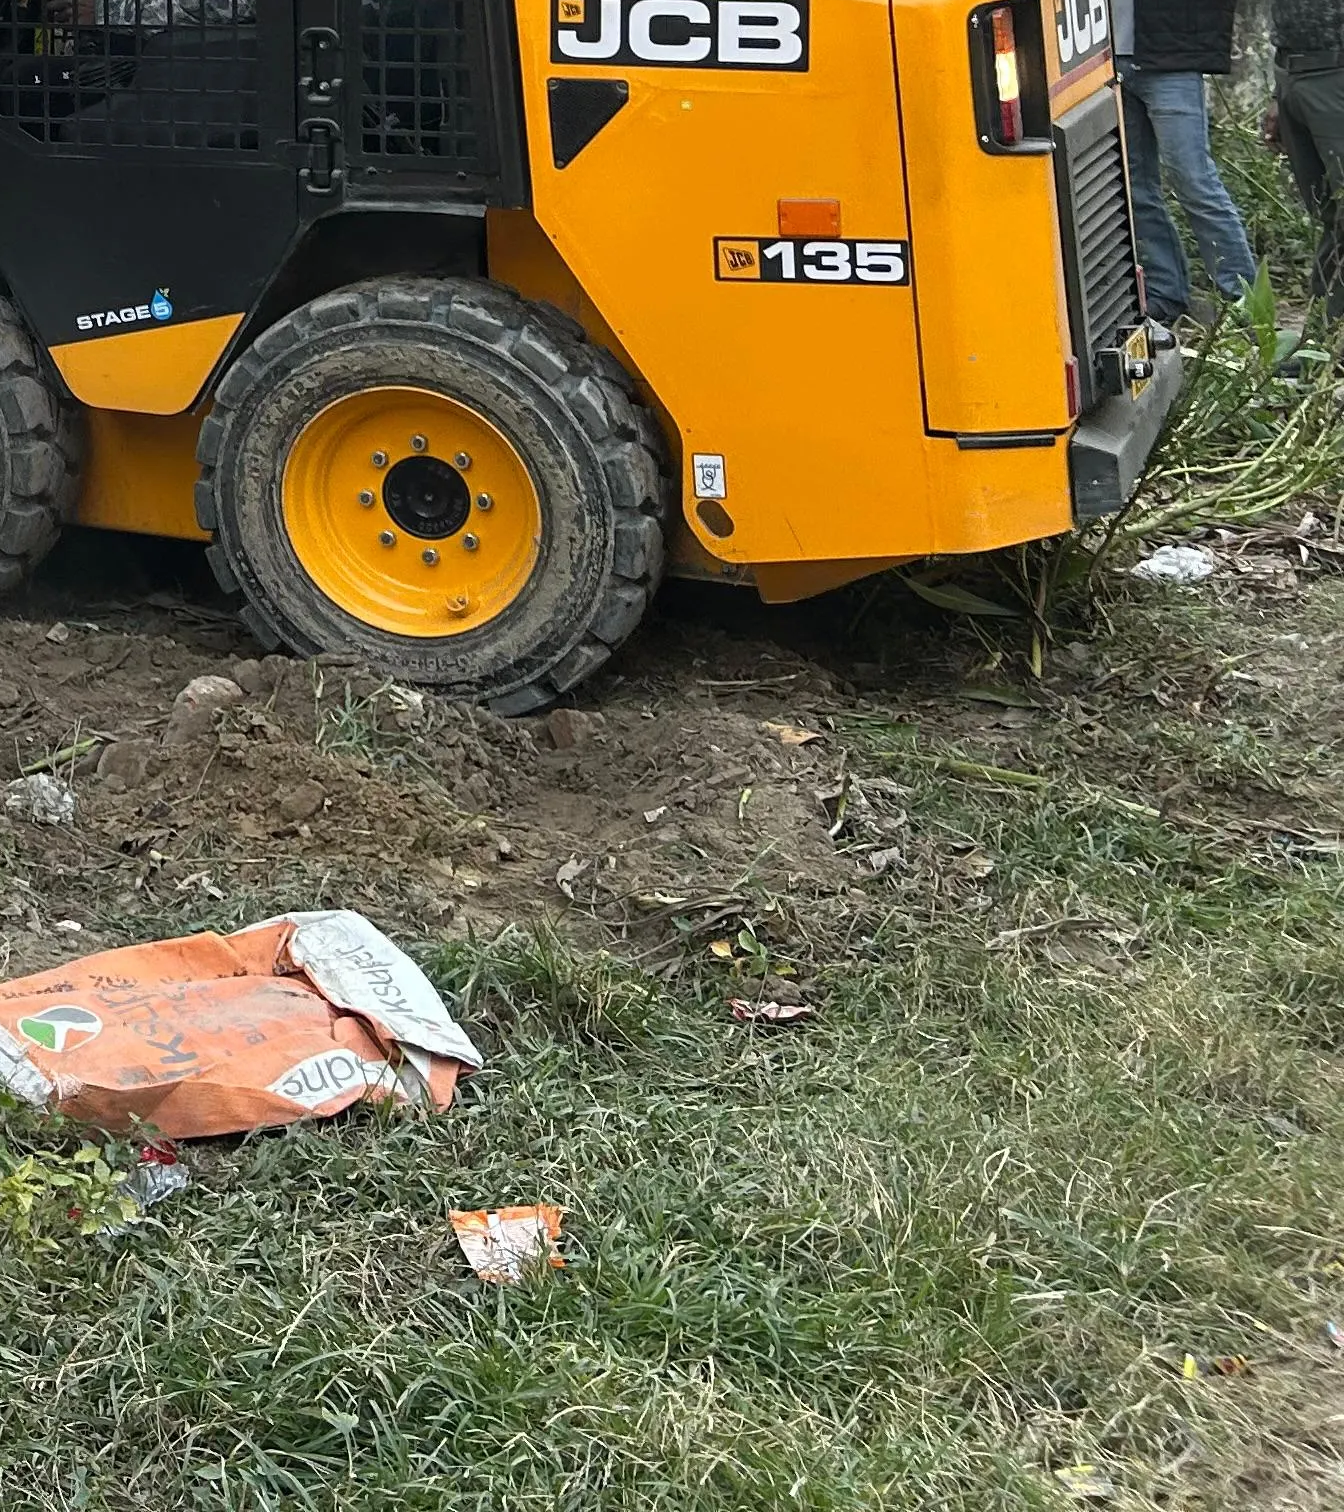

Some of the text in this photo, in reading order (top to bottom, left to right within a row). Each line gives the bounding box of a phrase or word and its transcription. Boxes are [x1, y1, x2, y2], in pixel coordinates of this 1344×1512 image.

[727, 249, 755, 269] JCB
[763, 241, 904, 282] 135
[76, 301, 170, 330] STAGE 5
